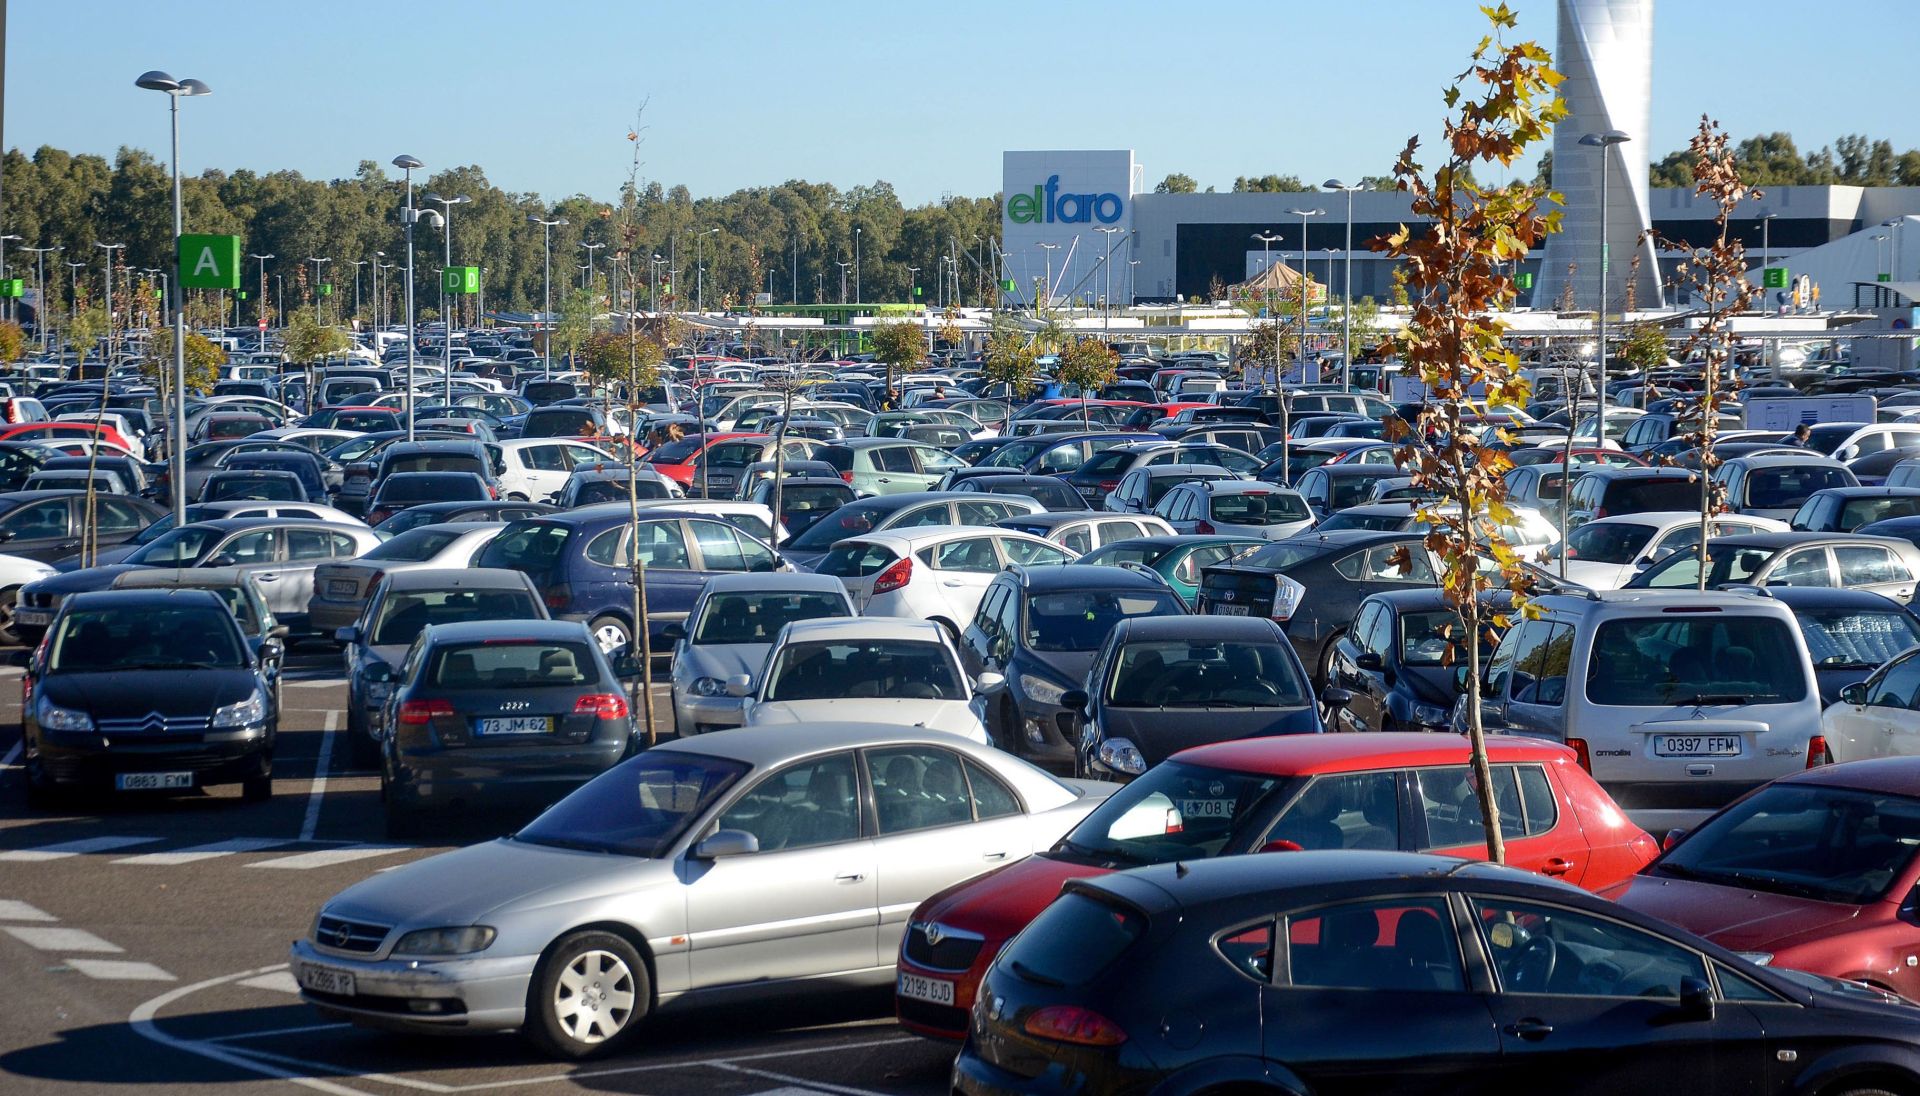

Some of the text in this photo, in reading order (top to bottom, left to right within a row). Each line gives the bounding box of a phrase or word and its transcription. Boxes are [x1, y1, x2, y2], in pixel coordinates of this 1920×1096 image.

[193, 246, 220, 276] A
[449, 272, 461, 288] D
[468, 272, 476, 288] D
[1770, 272, 1778, 284] E
[3, 282, 10, 293] F
[1667, 738, 1734, 752] 0397 FFM
[903, 975, 950, 1002] 2199 GJD
